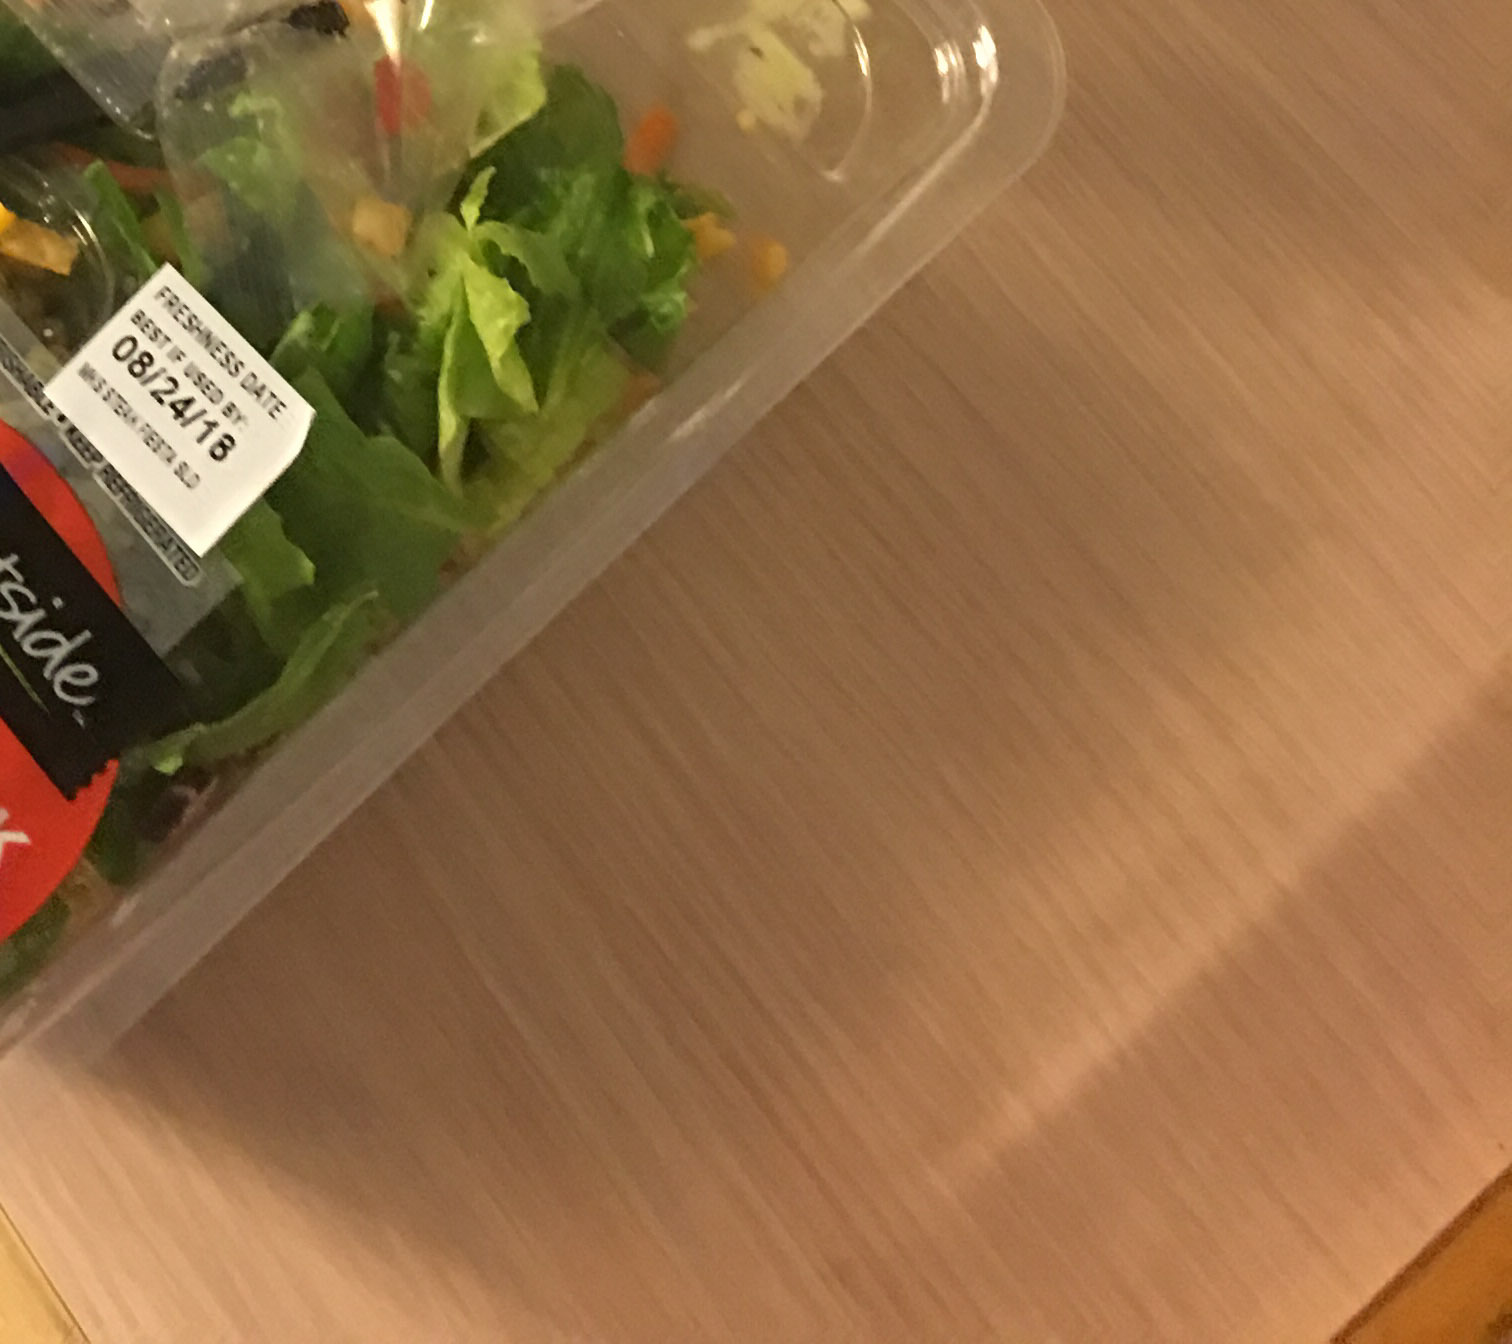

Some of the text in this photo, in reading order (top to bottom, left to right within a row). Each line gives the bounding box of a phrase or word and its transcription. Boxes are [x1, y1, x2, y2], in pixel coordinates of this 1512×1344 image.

[112, 335, 236, 462] 08/24/18
[130, 309, 171, 349] BEST
[166, 346, 187, 364] IF
[184, 361, 224, 405] USED
[155, 285, 287, 420] FRESHNESS DATE
